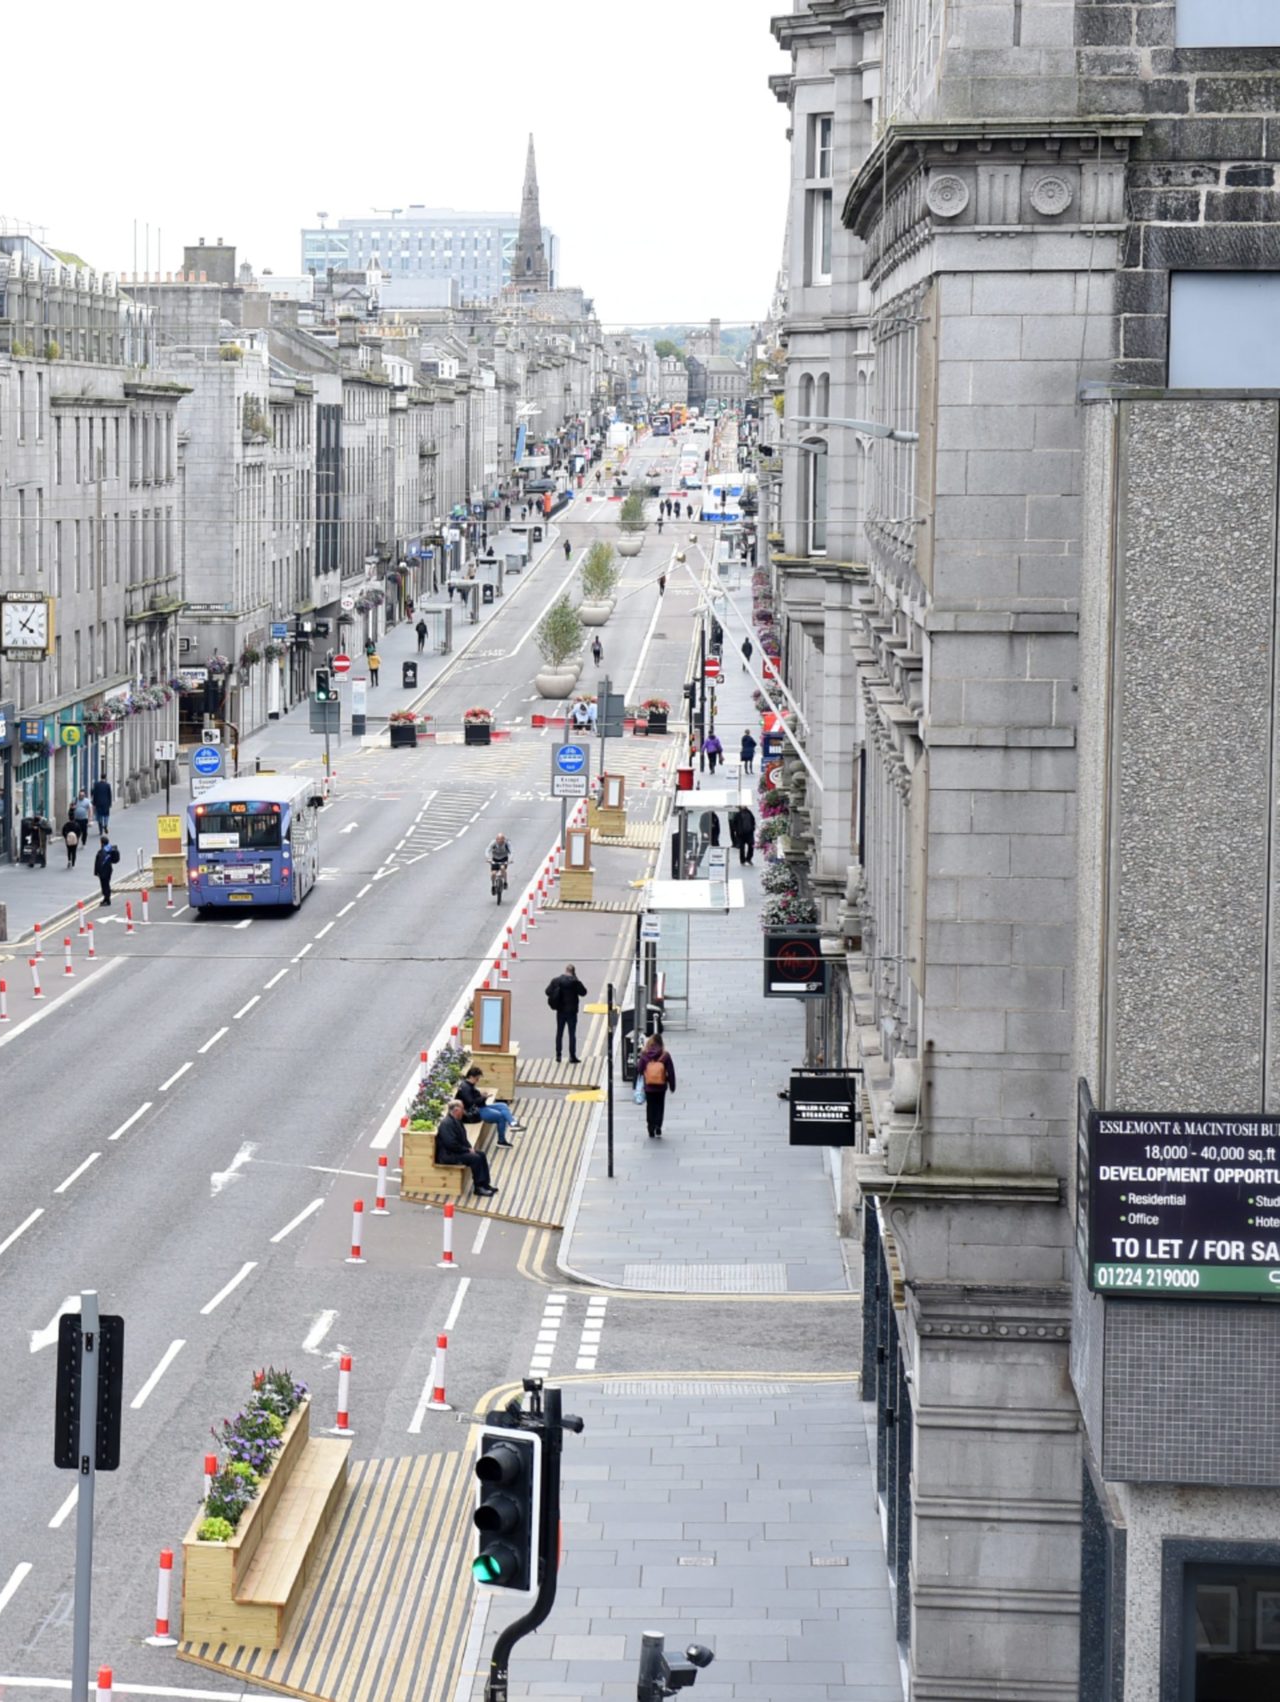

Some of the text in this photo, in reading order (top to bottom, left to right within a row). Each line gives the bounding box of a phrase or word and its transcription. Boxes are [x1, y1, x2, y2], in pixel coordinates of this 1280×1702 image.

[1099, 1120, 1171, 1134] ESSLEMONT
[1173, 1123, 1181, 1135] &
[1184, 1122, 1258, 1136] MACINTOSH
[1144, 1145, 1188, 1160] 18,000
[1200, 1146, 1244, 1162] 40,000
[1248, 1147, 1276, 1164] sq.ft
[1099, 1166, 1210, 1183] DEVELOPMENT
[1128, 1193, 1186, 1206] Residential
[1255, 1195, 1280, 1207] Stud
[1128, 1212, 1160, 1226] Office
[1112, 1237, 1280, 1262] TO LET / FOR SA
[1098, 1266, 1200, 1288] 01224 219000
